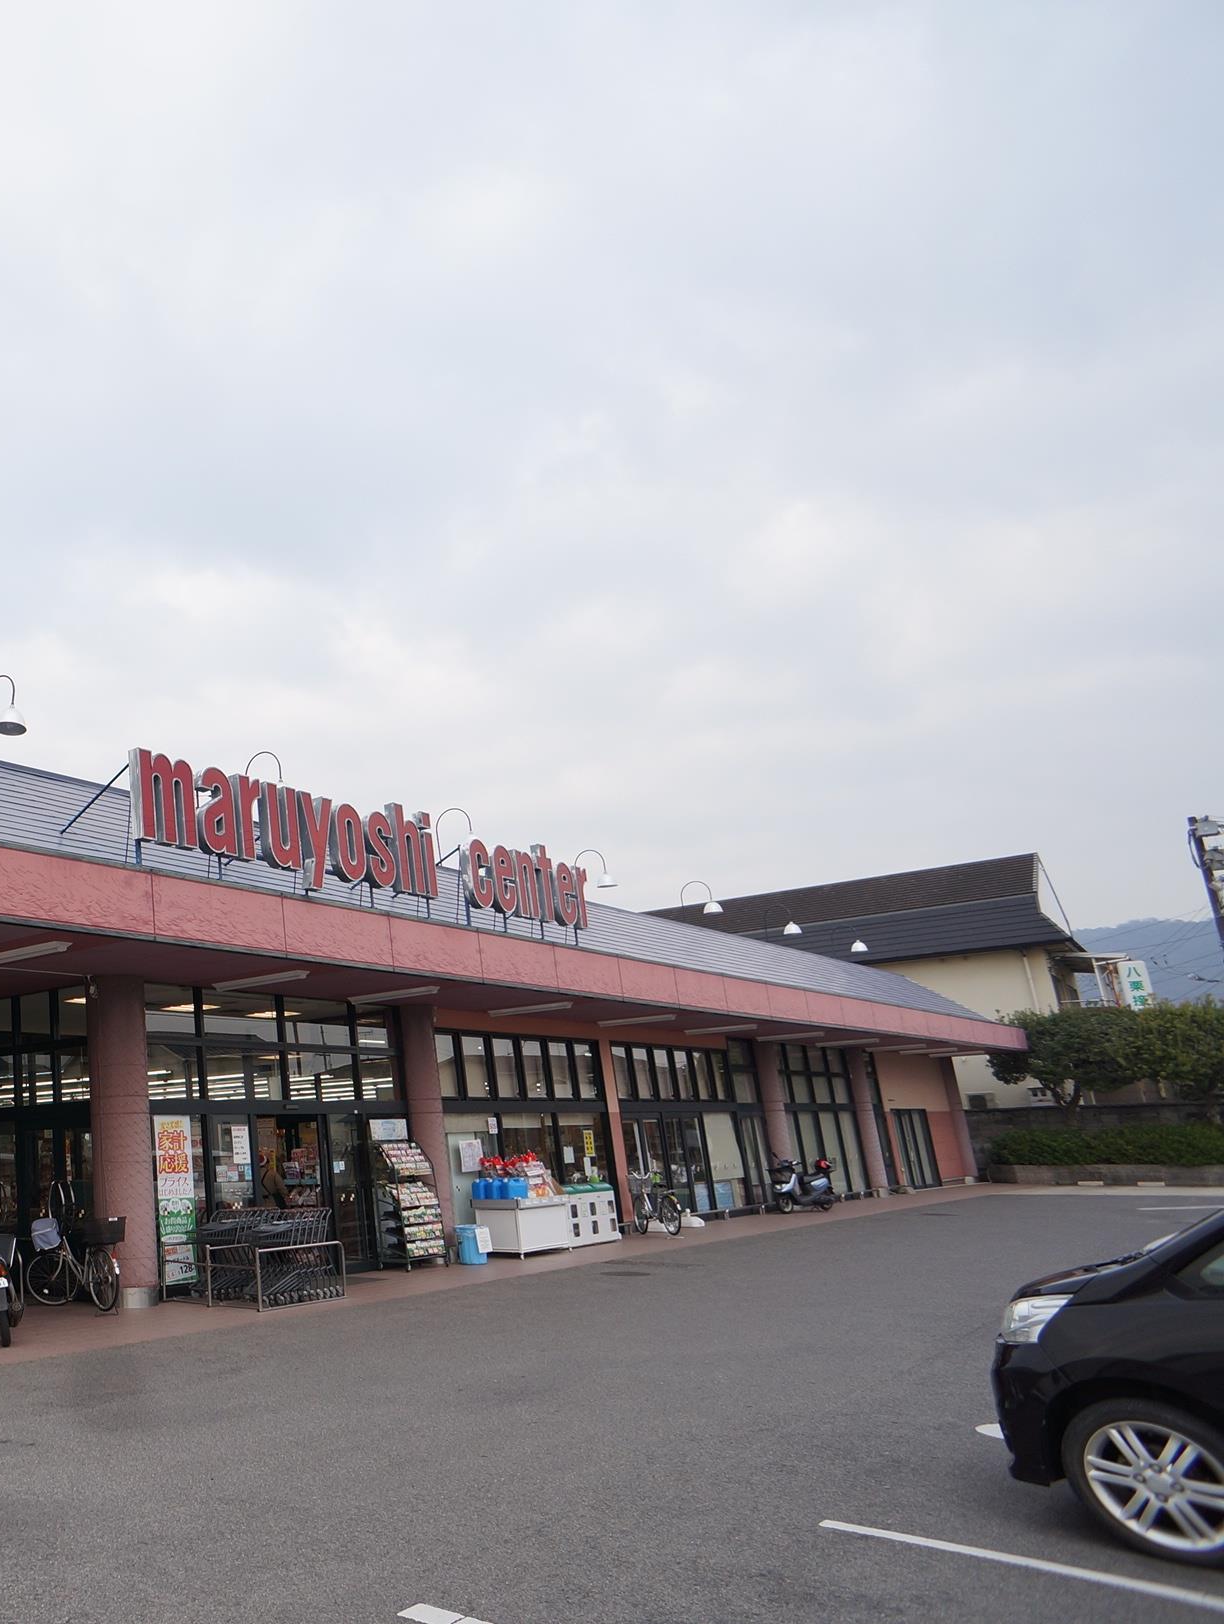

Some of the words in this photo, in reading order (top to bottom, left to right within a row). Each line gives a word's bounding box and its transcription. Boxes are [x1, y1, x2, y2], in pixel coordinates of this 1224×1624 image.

[129, 748, 438, 898] maruyoshi
[460, 838, 588, 929] center
[158, 1130, 187, 1151] 家計
[159, 1153, 189, 1174] 応援
